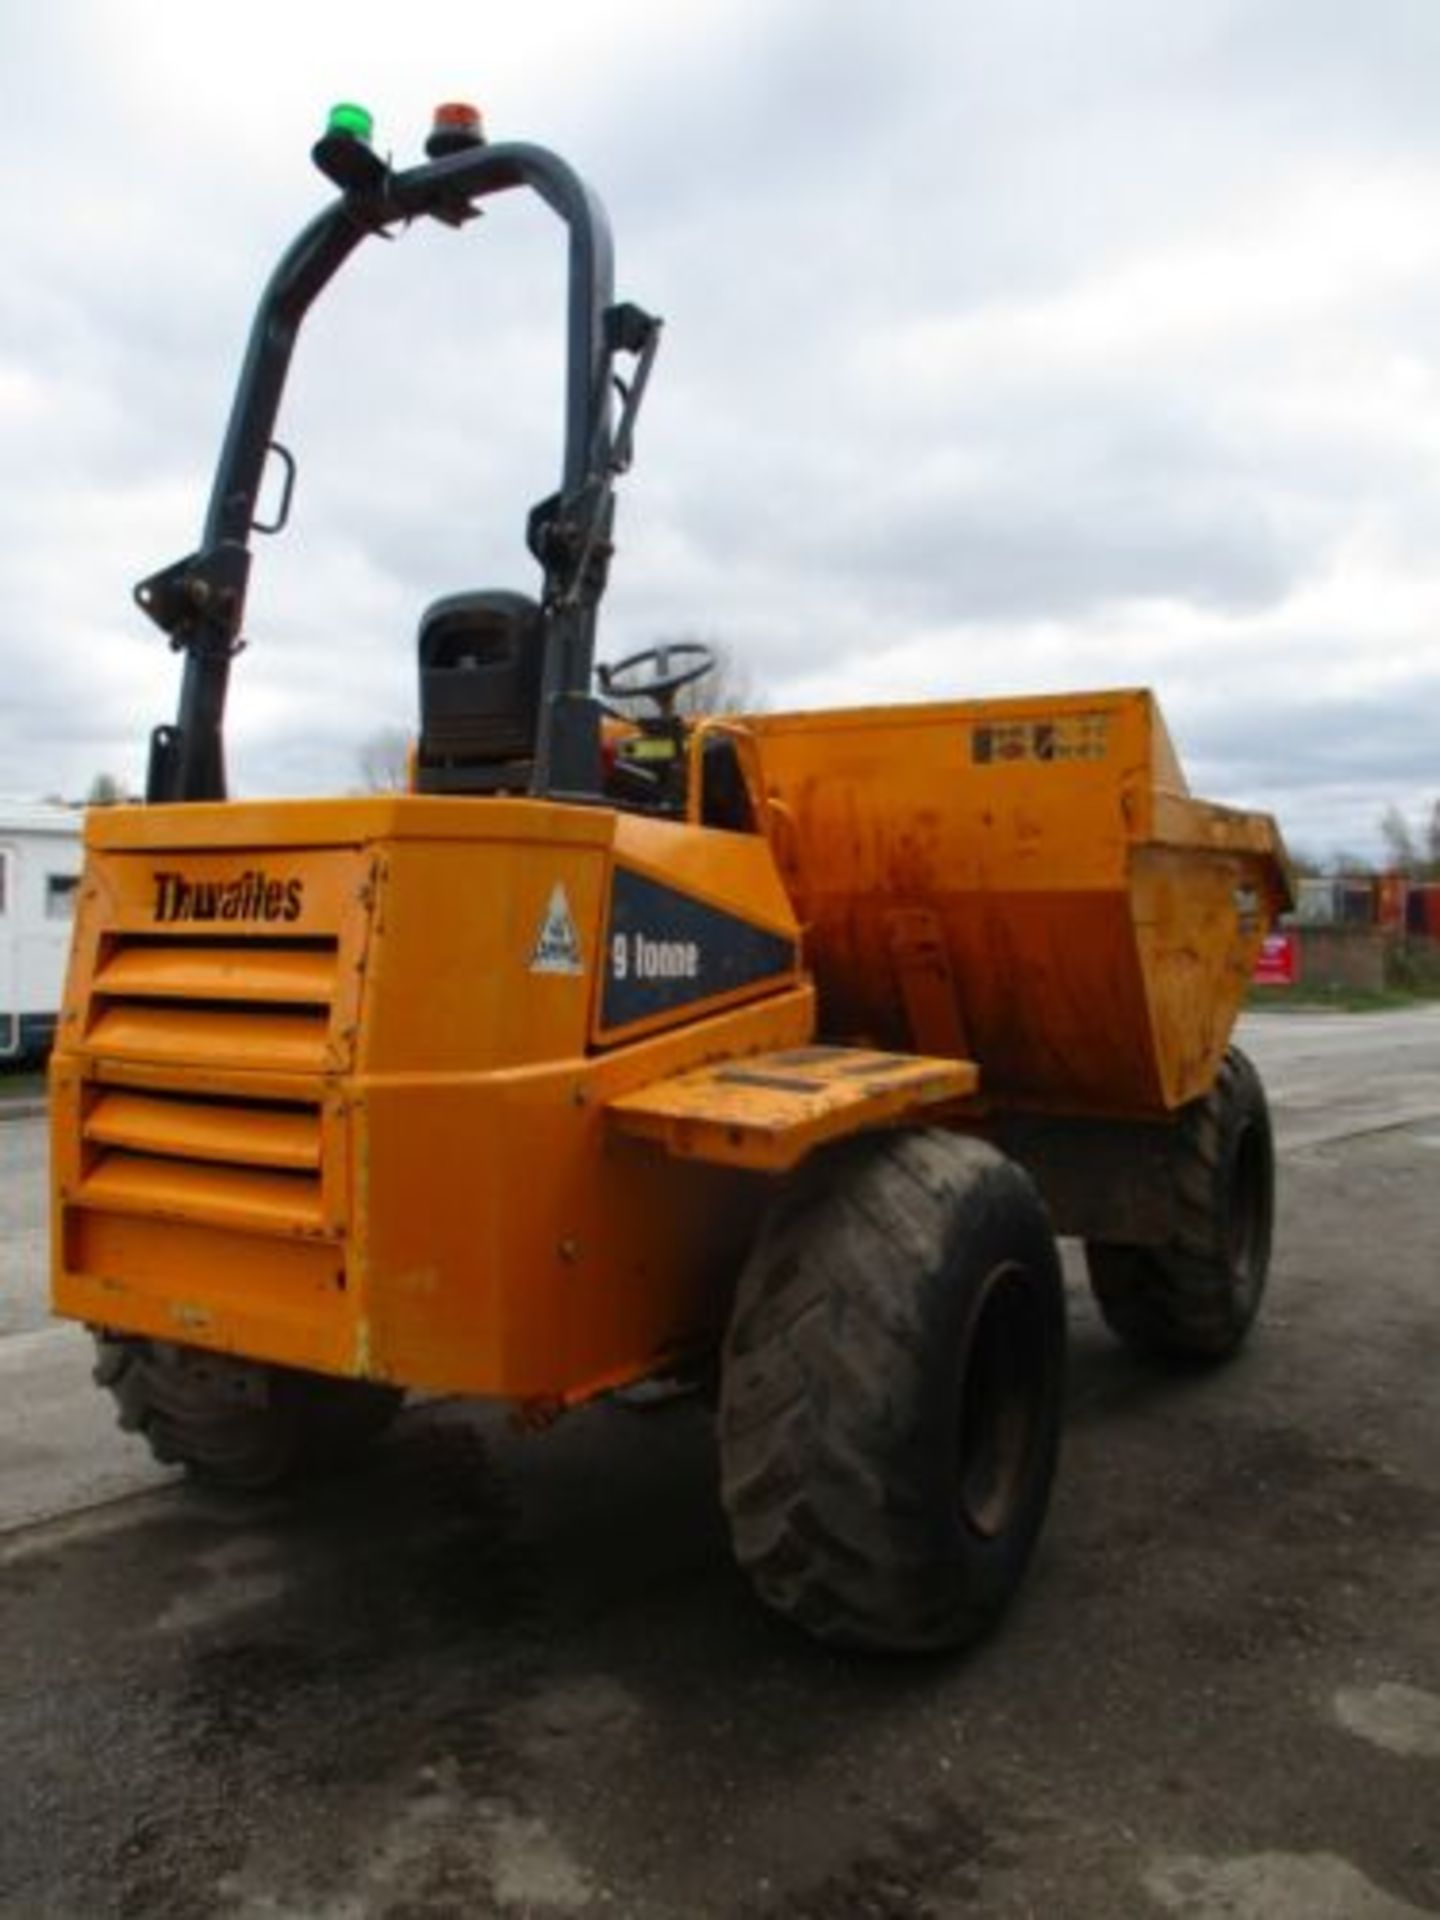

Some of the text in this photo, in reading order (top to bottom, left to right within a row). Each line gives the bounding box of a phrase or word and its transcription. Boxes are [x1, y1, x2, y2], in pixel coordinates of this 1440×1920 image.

[153, 870, 303, 922] Thwaites
[613, 933, 627, 980] 9
[636, 933, 699, 978] tonne
